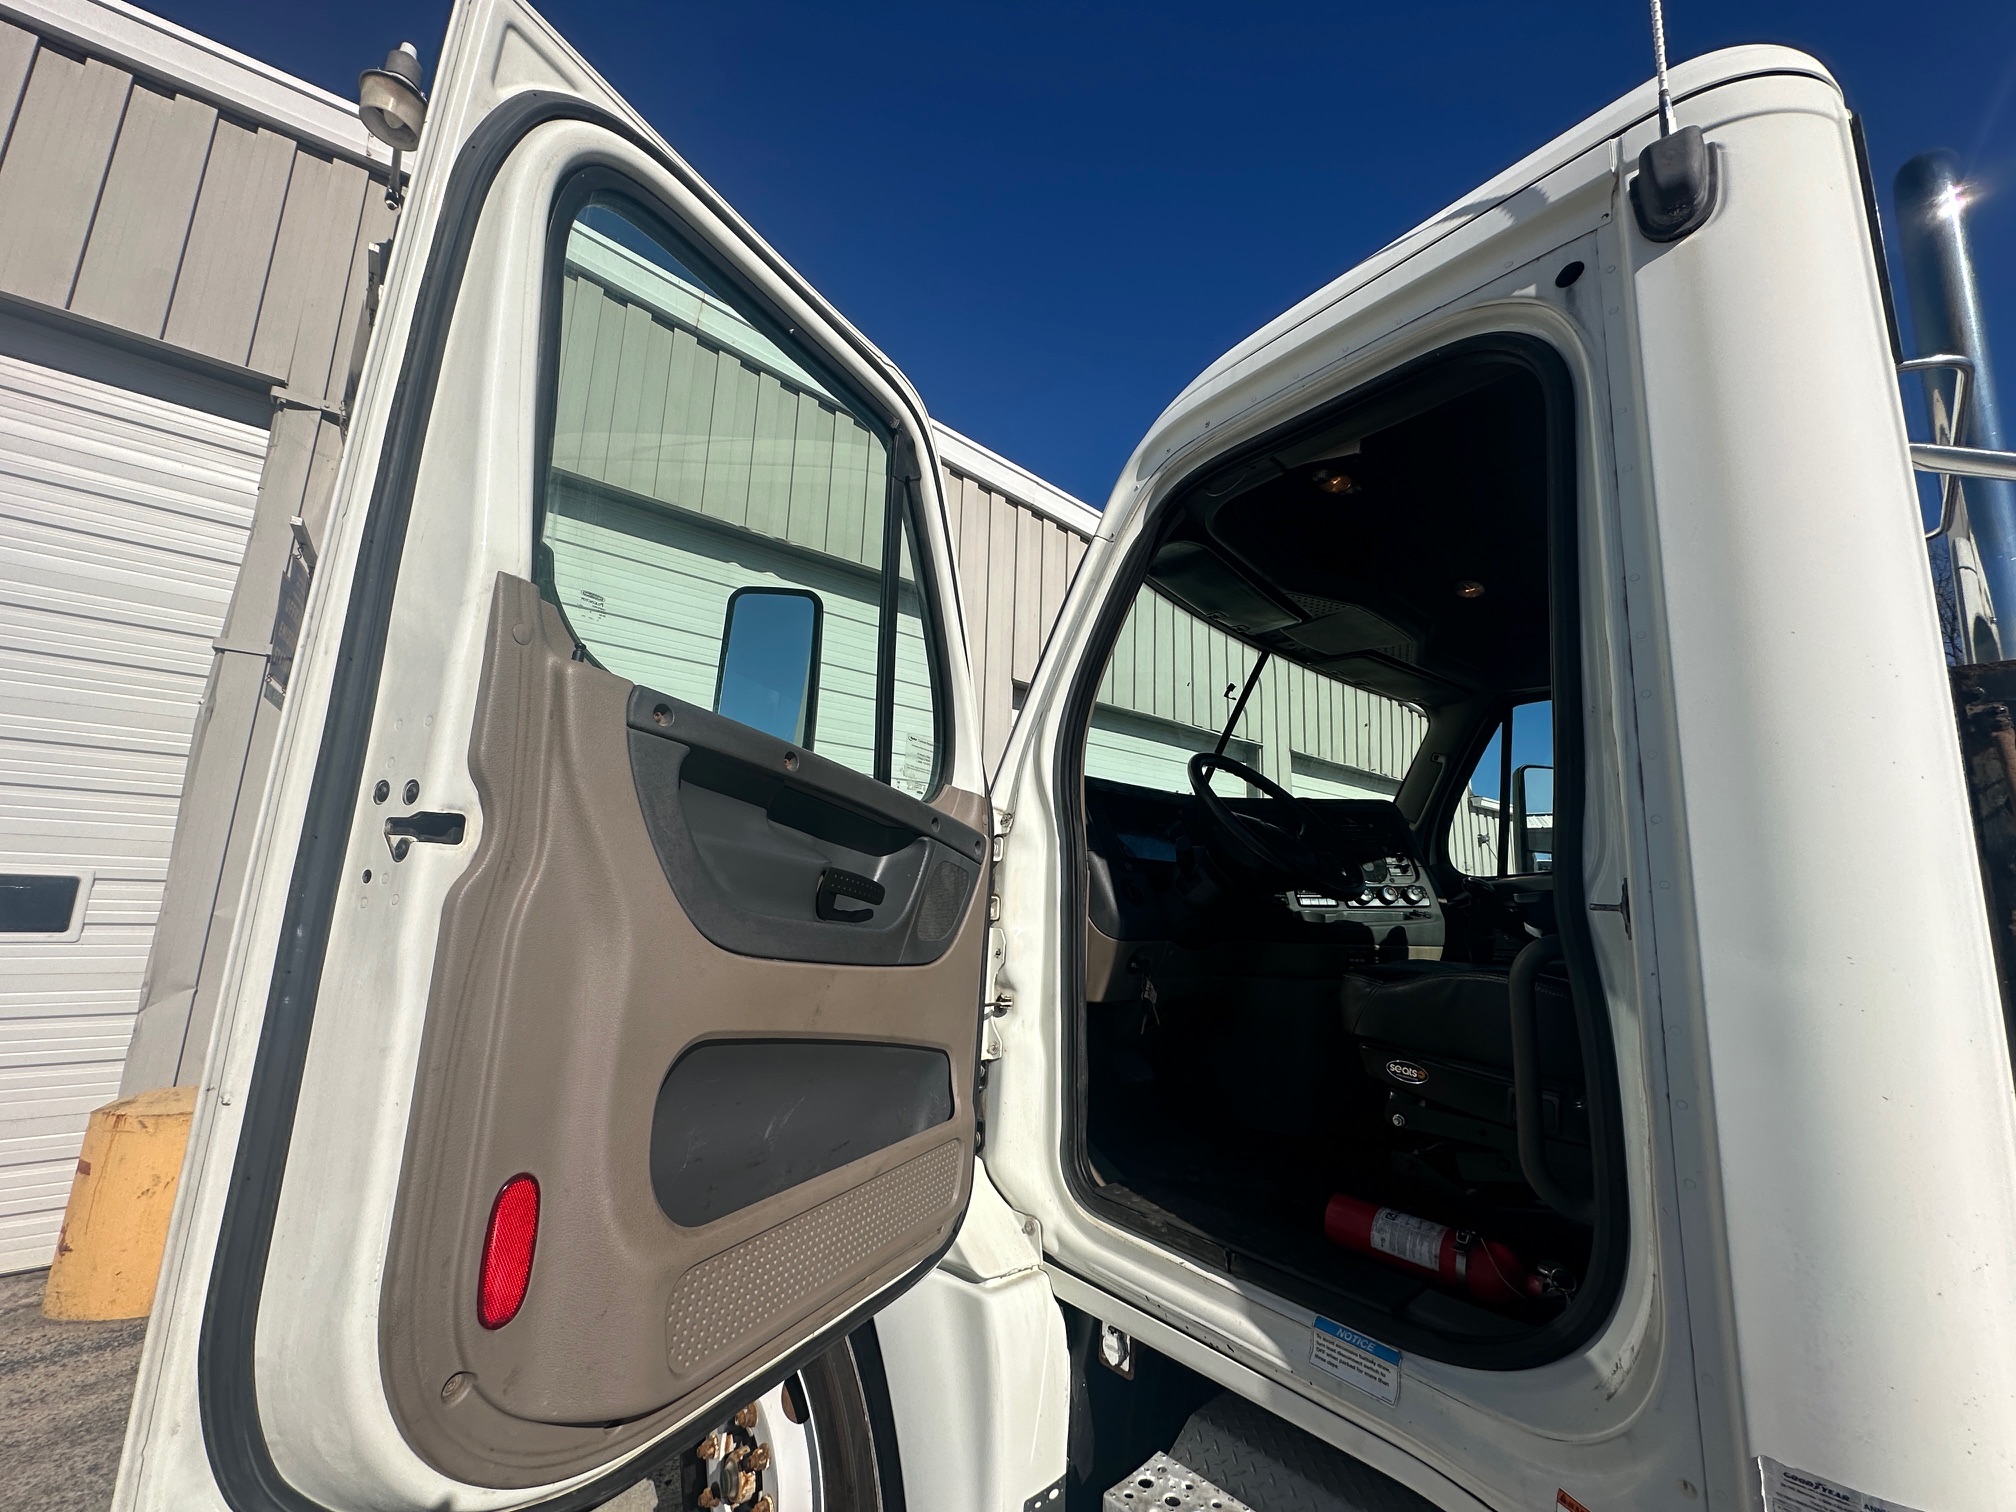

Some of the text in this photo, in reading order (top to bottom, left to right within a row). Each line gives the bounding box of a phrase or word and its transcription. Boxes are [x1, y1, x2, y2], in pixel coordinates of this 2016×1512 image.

[1389, 1063, 1418, 1078] seats
[1322, 1335, 1335, 1346] avoid
[1336, 1342, 1358, 1357] excessive
[1358, 1353, 1376, 1367] battery
[1336, 1328, 1376, 1353] NOTICE
[1314, 1353, 1327, 1363] three
[1316, 1341, 1326, 1349] turn
[1337, 1350, 1363, 1366] disconnect
[1364, 1362, 1380, 1374] switch
[1316, 1346, 1390, 1387] OFF when parked for more than
[1783, 1471, 1850, 1502] GOODYEAR
